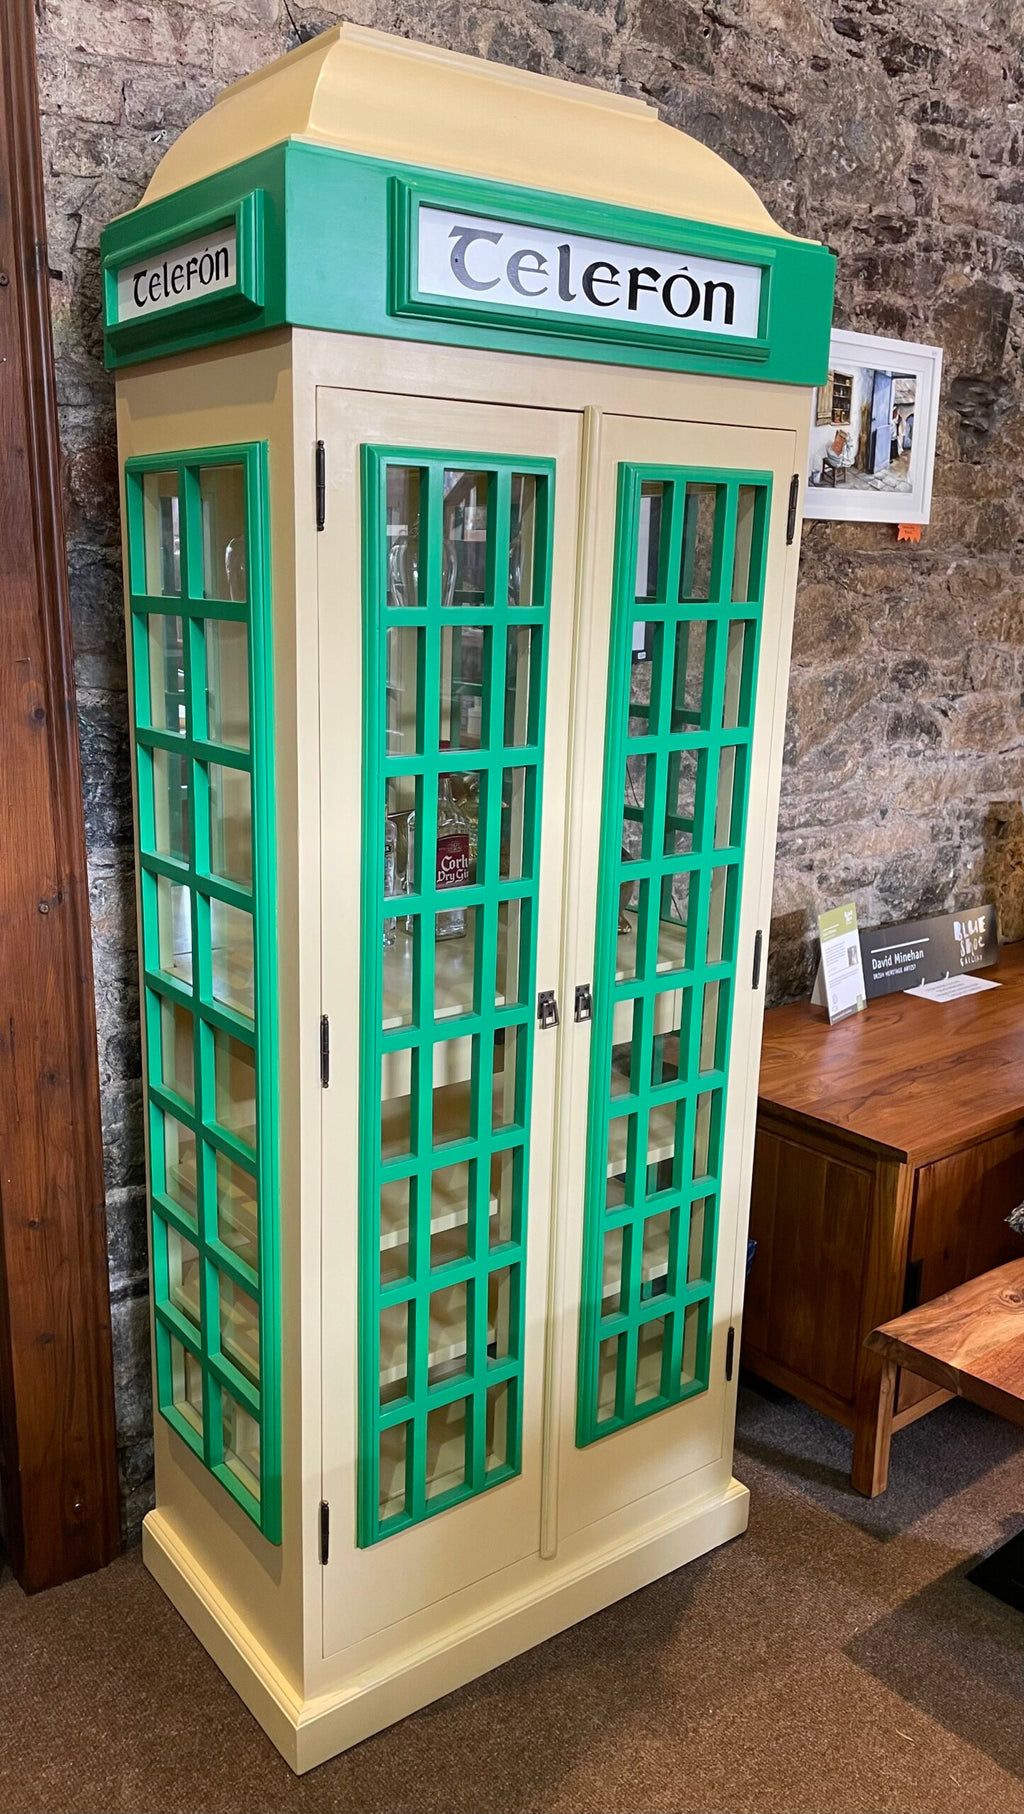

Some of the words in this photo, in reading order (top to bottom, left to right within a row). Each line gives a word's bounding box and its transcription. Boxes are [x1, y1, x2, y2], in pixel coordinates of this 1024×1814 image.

[132, 246, 230, 308] Telefón
[447, 224, 735, 326] Telefón
[436, 870, 455, 885] Dry
[953, 915, 986, 942] BLUE
[871, 954, 893, 970] David
[894, 949, 925, 965] Minehan
